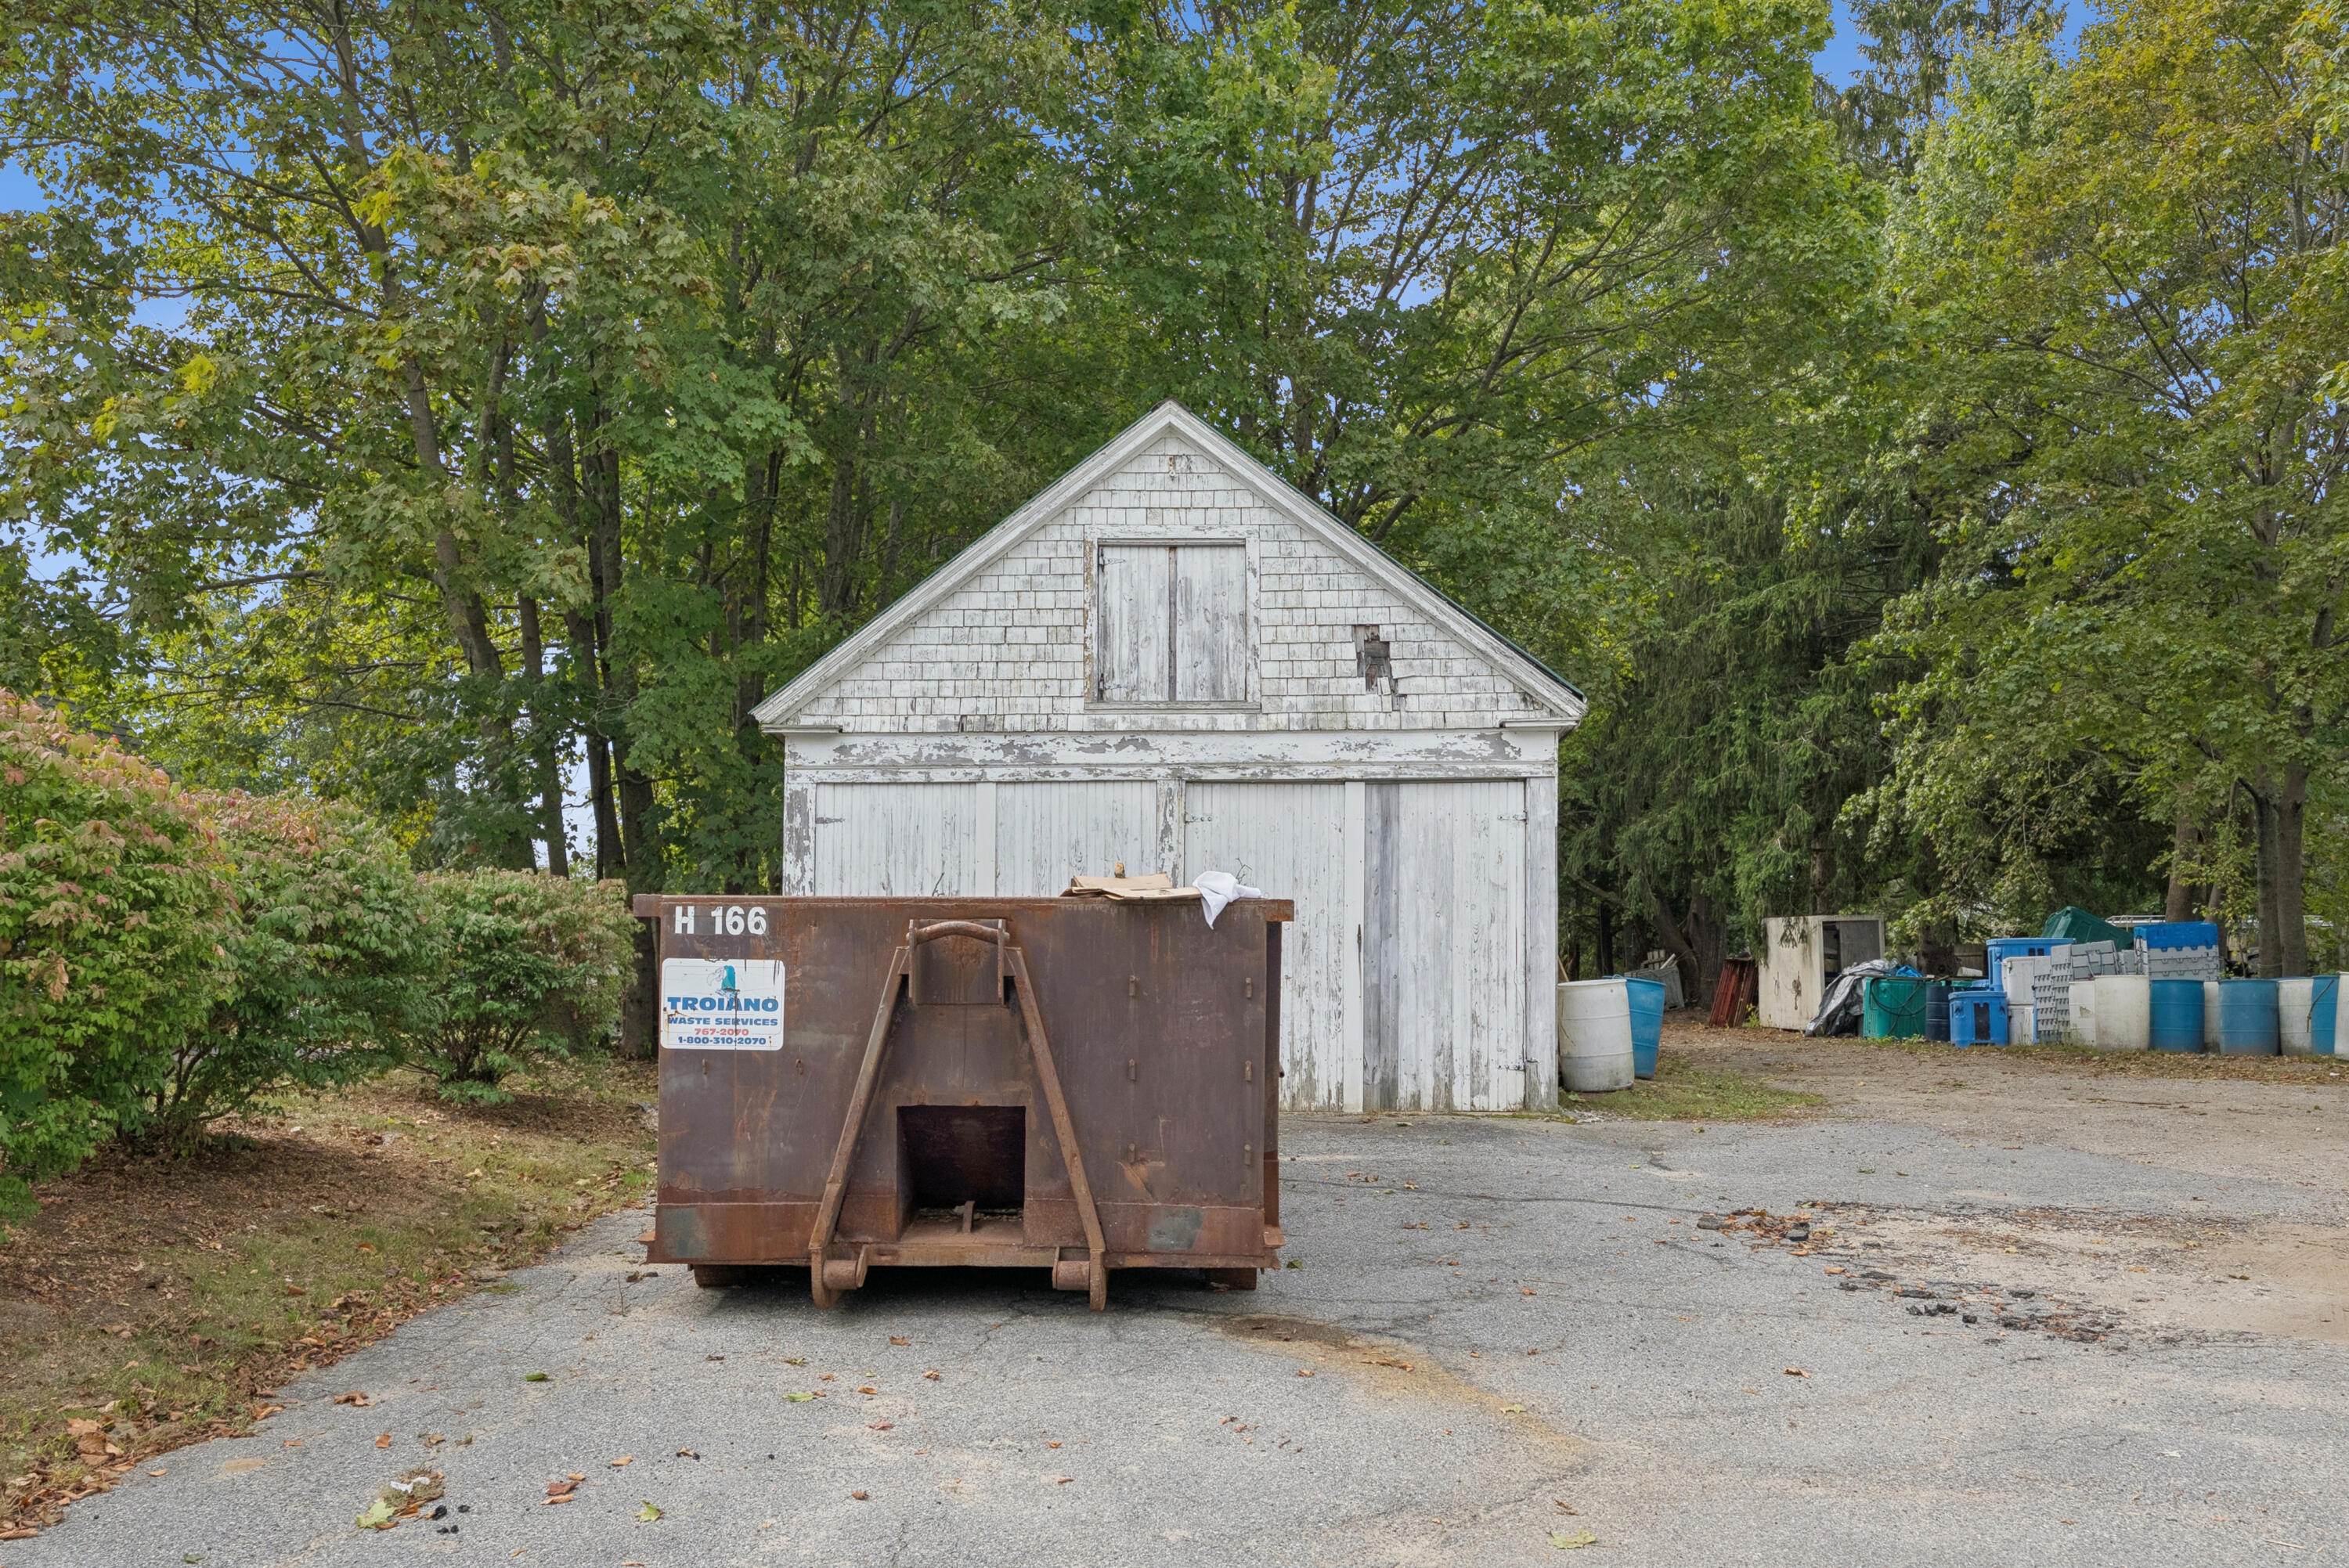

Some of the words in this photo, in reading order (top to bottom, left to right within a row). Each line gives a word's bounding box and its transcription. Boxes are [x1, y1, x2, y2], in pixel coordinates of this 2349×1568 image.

[675, 906, 695, 935] H
[710, 906, 767, 935] 166
[667, 997, 779, 1011] TROIANO
[678, 1036, 767, 1045] 1-800-310-2070
